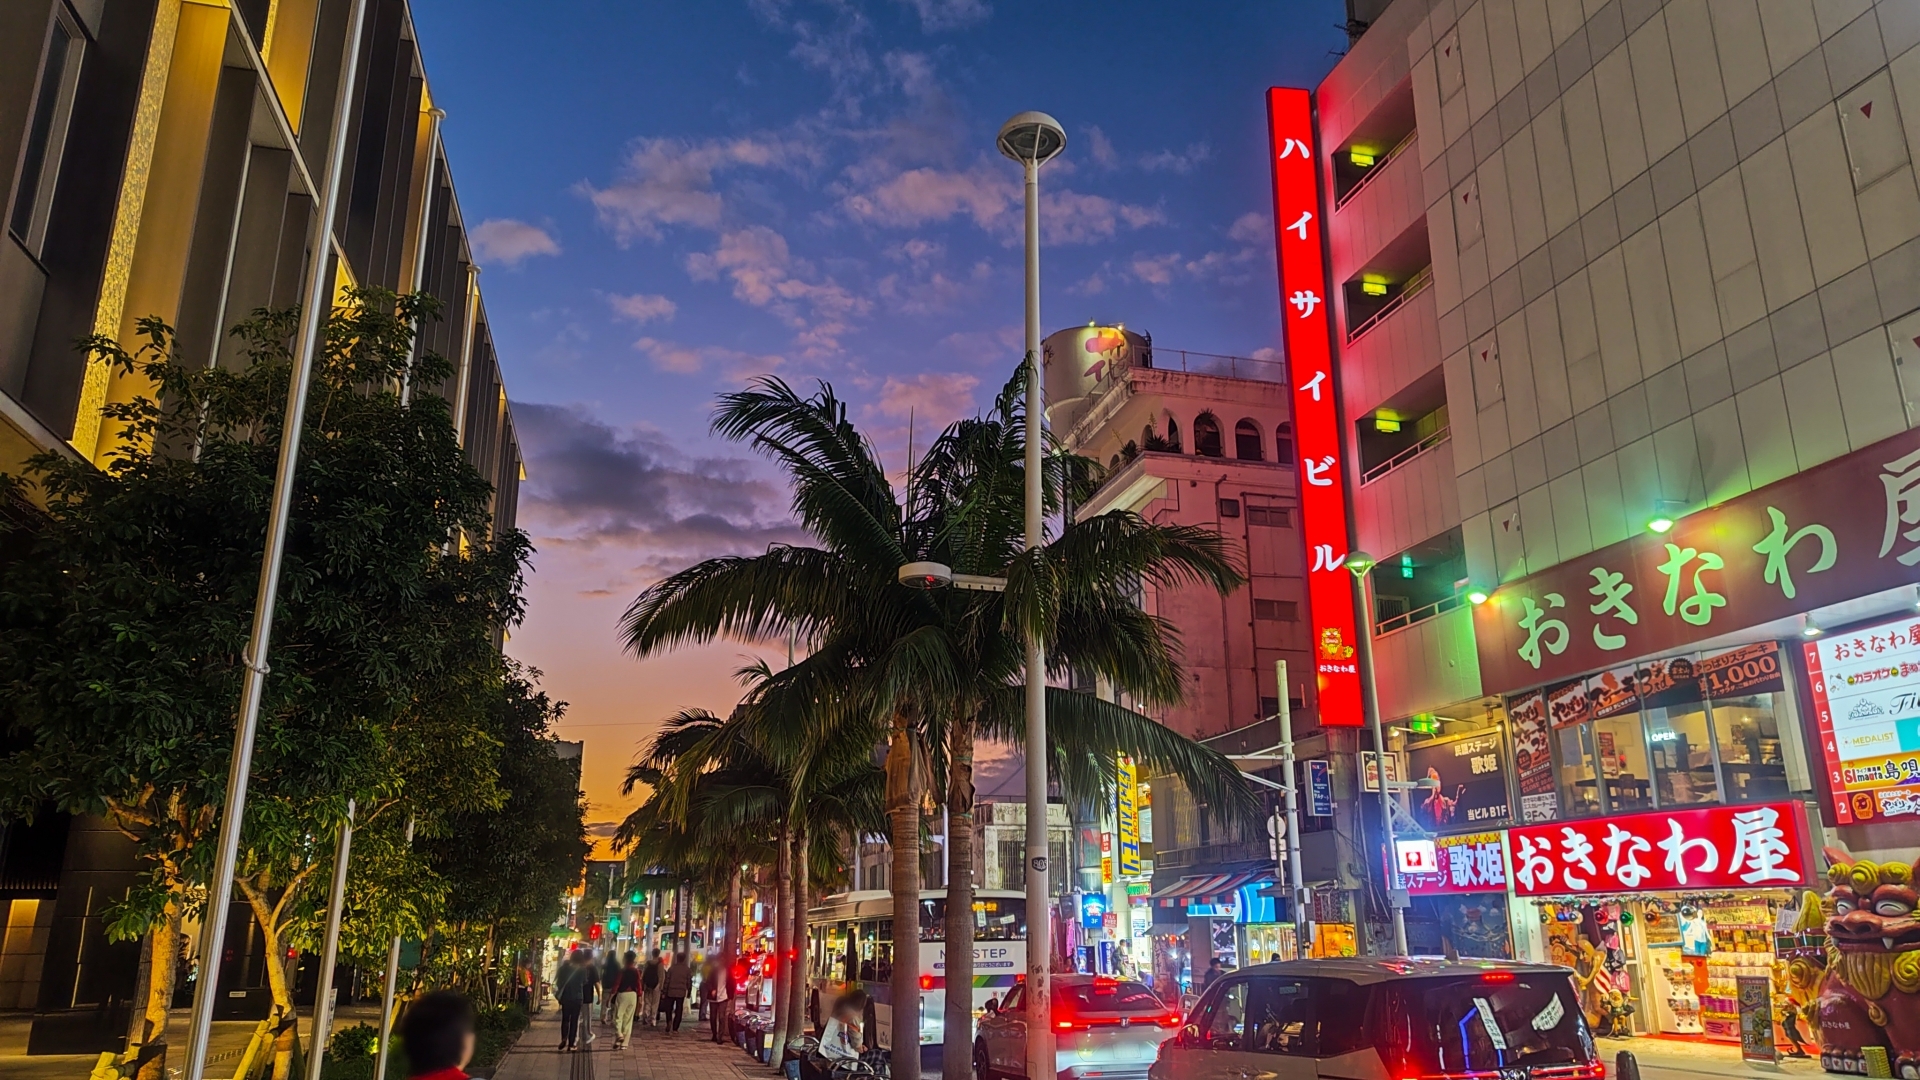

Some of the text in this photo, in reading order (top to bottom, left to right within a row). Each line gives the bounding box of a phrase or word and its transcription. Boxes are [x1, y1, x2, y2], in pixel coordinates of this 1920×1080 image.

[1279, 137, 1348, 573] ハイサイビル
[1809, 652, 1816, 663] 7
[1319, 664, 1356, 674] おきなわ屋
[1709, 655, 1777, 691] 1,000
[1853, 668, 1891, 685] カラオケ
[1815, 681, 1823, 693] 6
[1889, 691, 1920, 716] Ti
[1821, 711, 1829, 723] 5
[1651, 731, 1676, 742] OPEN
[1852, 732, 1894, 745] MEDALIST
[1454, 737, 1497, 757] 民謡ステージ
[1826, 741, 1835, 753] 4
[1471, 754, 1498, 775] 歌姫
[1833, 771, 1841, 783] 3
[1467, 804, 1507, 821] 当ビル B1F
[1838, 802, 1847, 814] 2
[1516, 807, 1800, 891] おきなわ屋
[1448, 842, 1505, 886] 歌姫
[1396, 870, 1448, 889] 謡ステージ
[973, 949, 1007, 958] STEP
[1822, 1021, 1850, 1029] おきなわ屋
[1743, 1034, 1754, 1044] 3F
